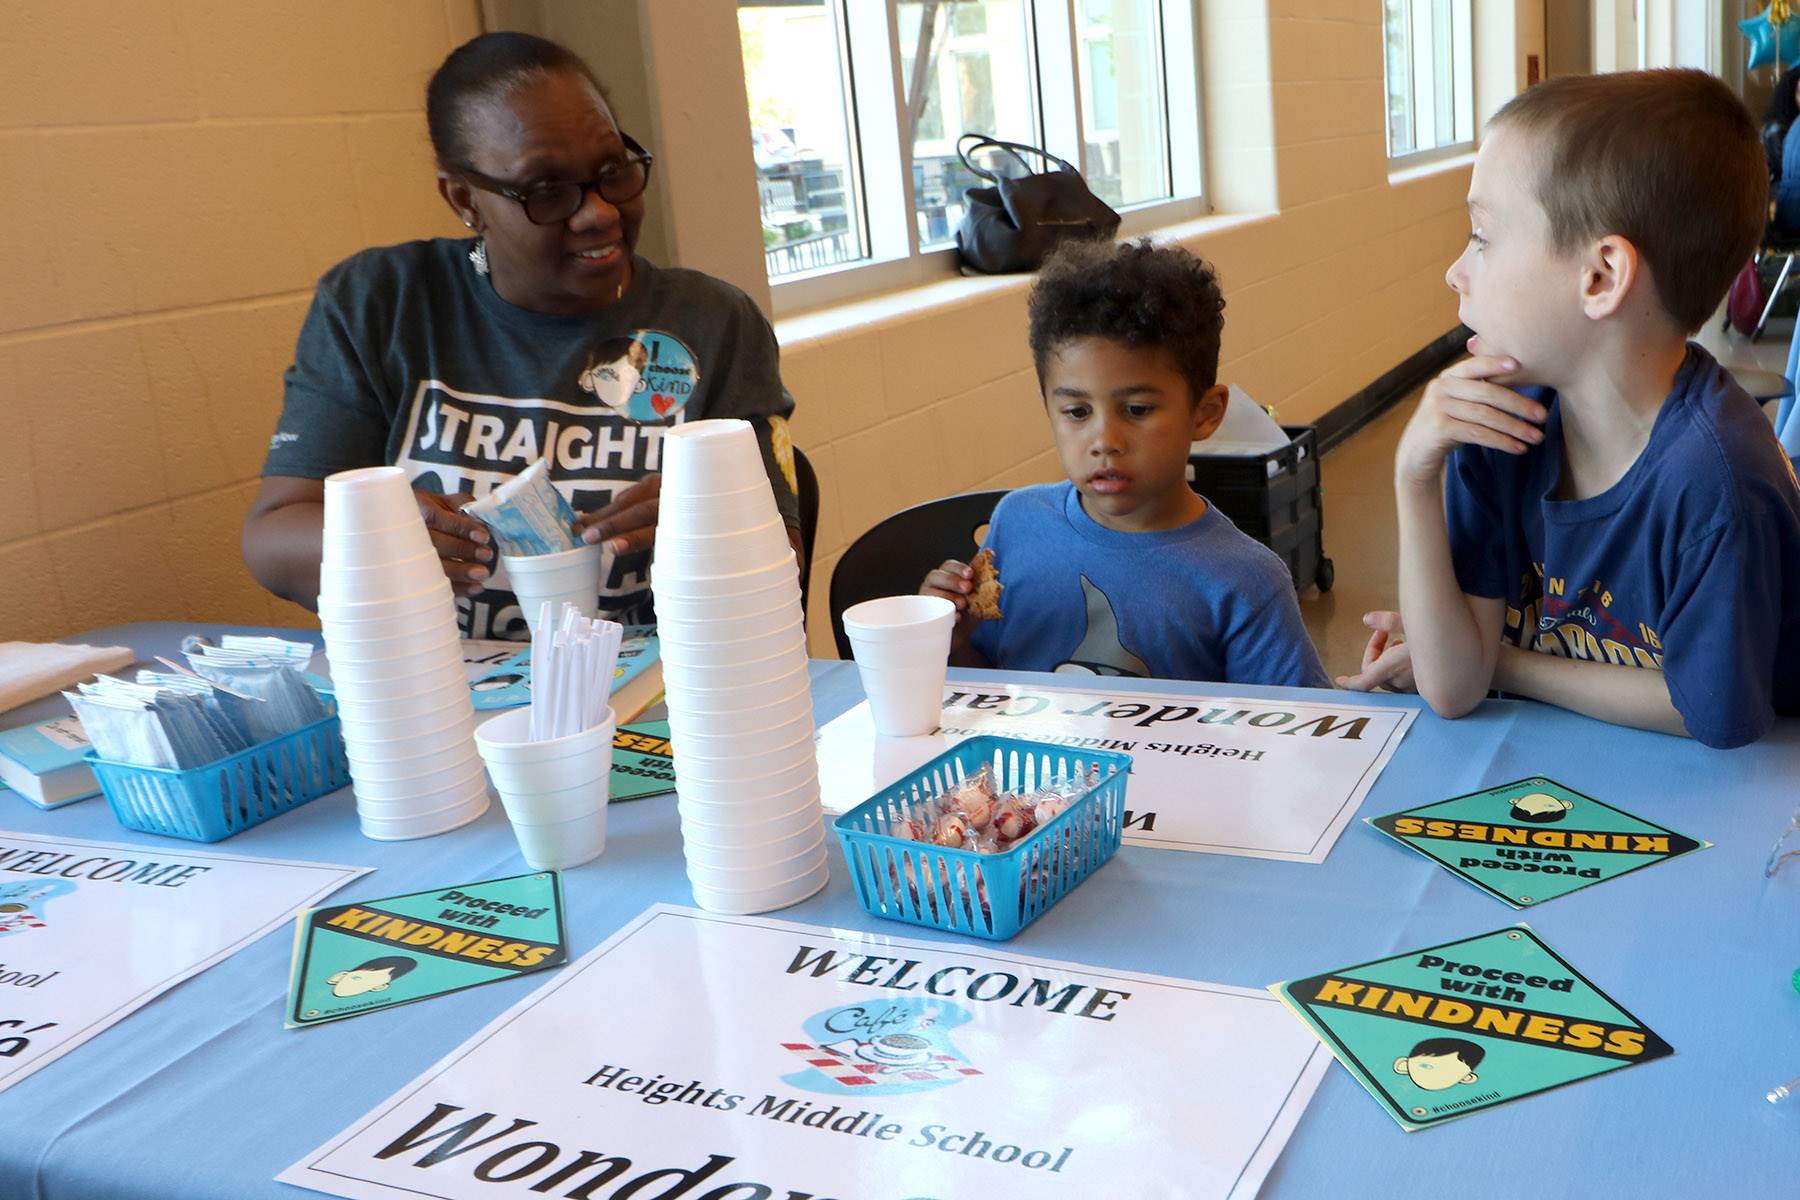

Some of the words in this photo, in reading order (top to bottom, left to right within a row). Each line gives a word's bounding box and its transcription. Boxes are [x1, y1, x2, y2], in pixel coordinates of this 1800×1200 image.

[419, 400, 665, 472] STRAIGHT
[1063, 701, 1371, 740] Wonder
[1145, 741, 1266, 762] Heights
[1395, 818, 1671, 854] KINDNESS
[1459, 856, 1601, 880] Proceed
[1496, 848, 1575, 864] with
[437, 890, 550, 920] Proceed
[438, 908, 500, 929] with
[326, 907, 556, 967] KINDNESS
[785, 944, 1132, 1022] WELCOME
[1417, 955, 1575, 994] Proceed
[1440, 977, 1527, 1003] with
[824, 1005, 908, 1034] Café
[1314, 979, 1647, 1057] KINDNESS
[583, 1065, 746, 1112] Heights
[746, 1094, 903, 1141] Middle
[908, 1124, 1074, 1173] School
